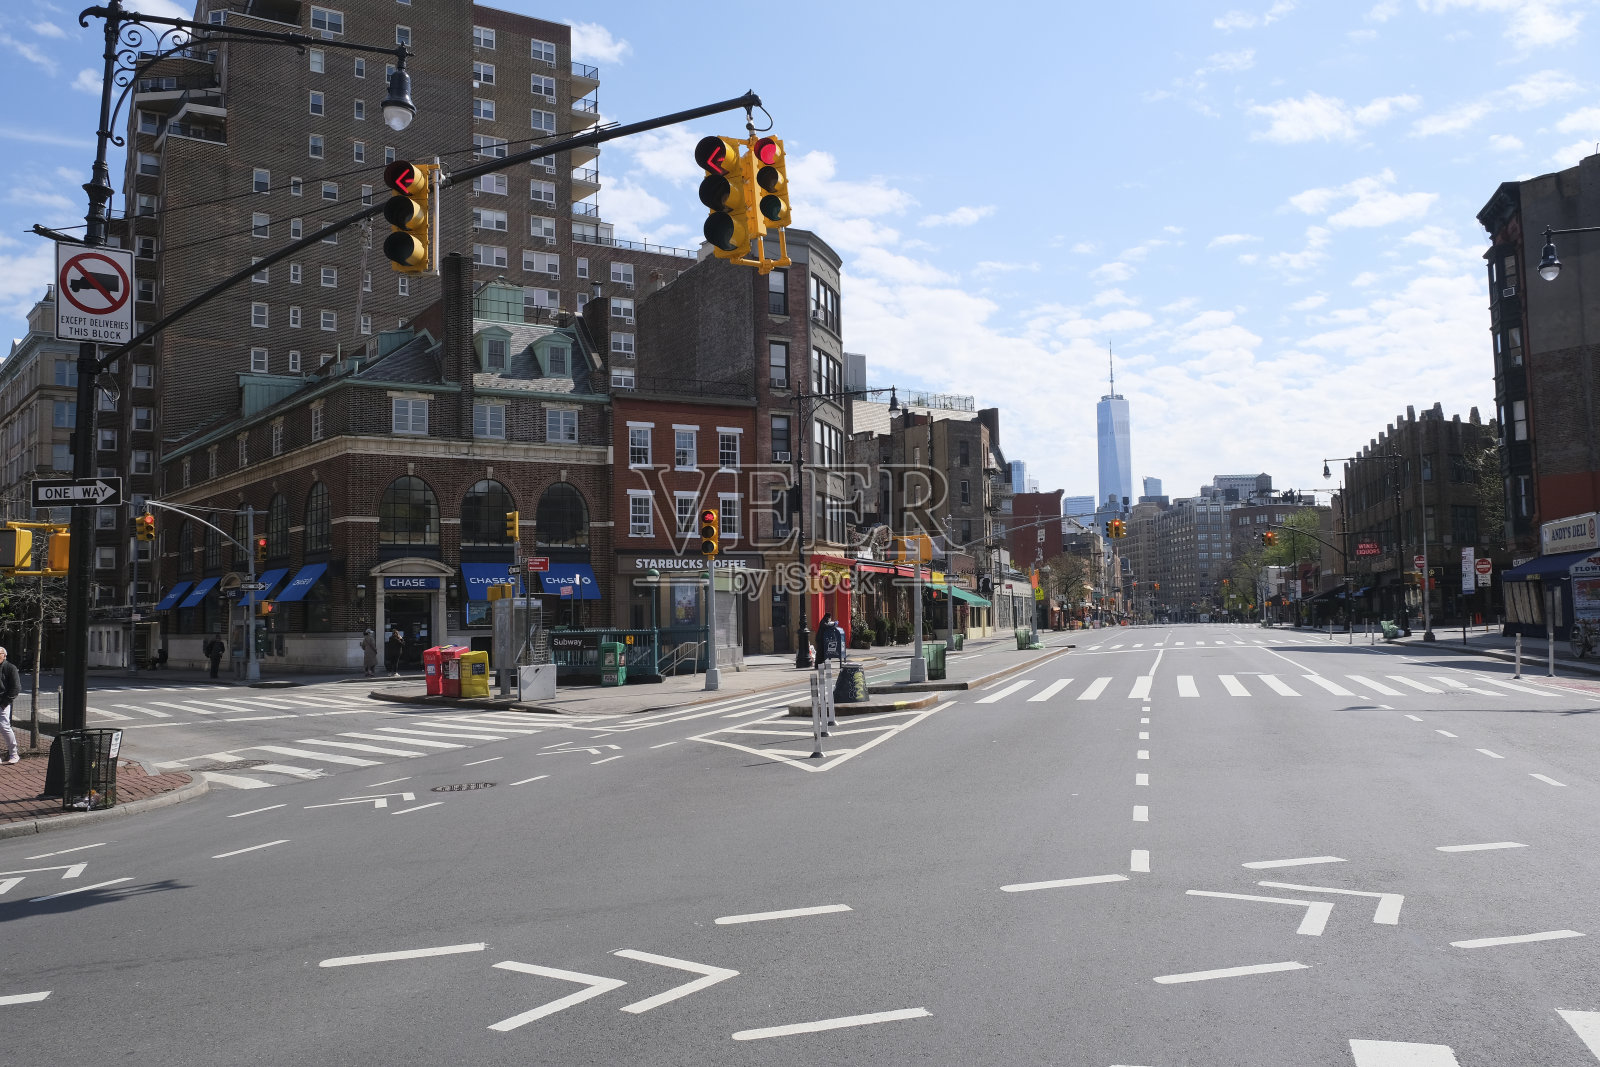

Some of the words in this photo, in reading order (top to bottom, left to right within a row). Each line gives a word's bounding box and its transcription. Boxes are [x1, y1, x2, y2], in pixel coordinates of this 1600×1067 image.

[61, 315, 87, 326] EXCEPT
[90, 318, 129, 330] DELIVERIES
[69, 326, 89, 337] THIS
[92, 329, 121, 340] BLOCK
[45, 487, 71, 499] ONE
[82, 486, 108, 498] WAY
[1551, 526, 1572, 541] ANDY'S
[1572, 523, 1587, 538] DELI
[635, 558, 704, 569] STARBUCKS
[389, 578, 426, 588] CHASE
[469, 577, 506, 585] CHASE
[553, 638, 583, 647] Subway
